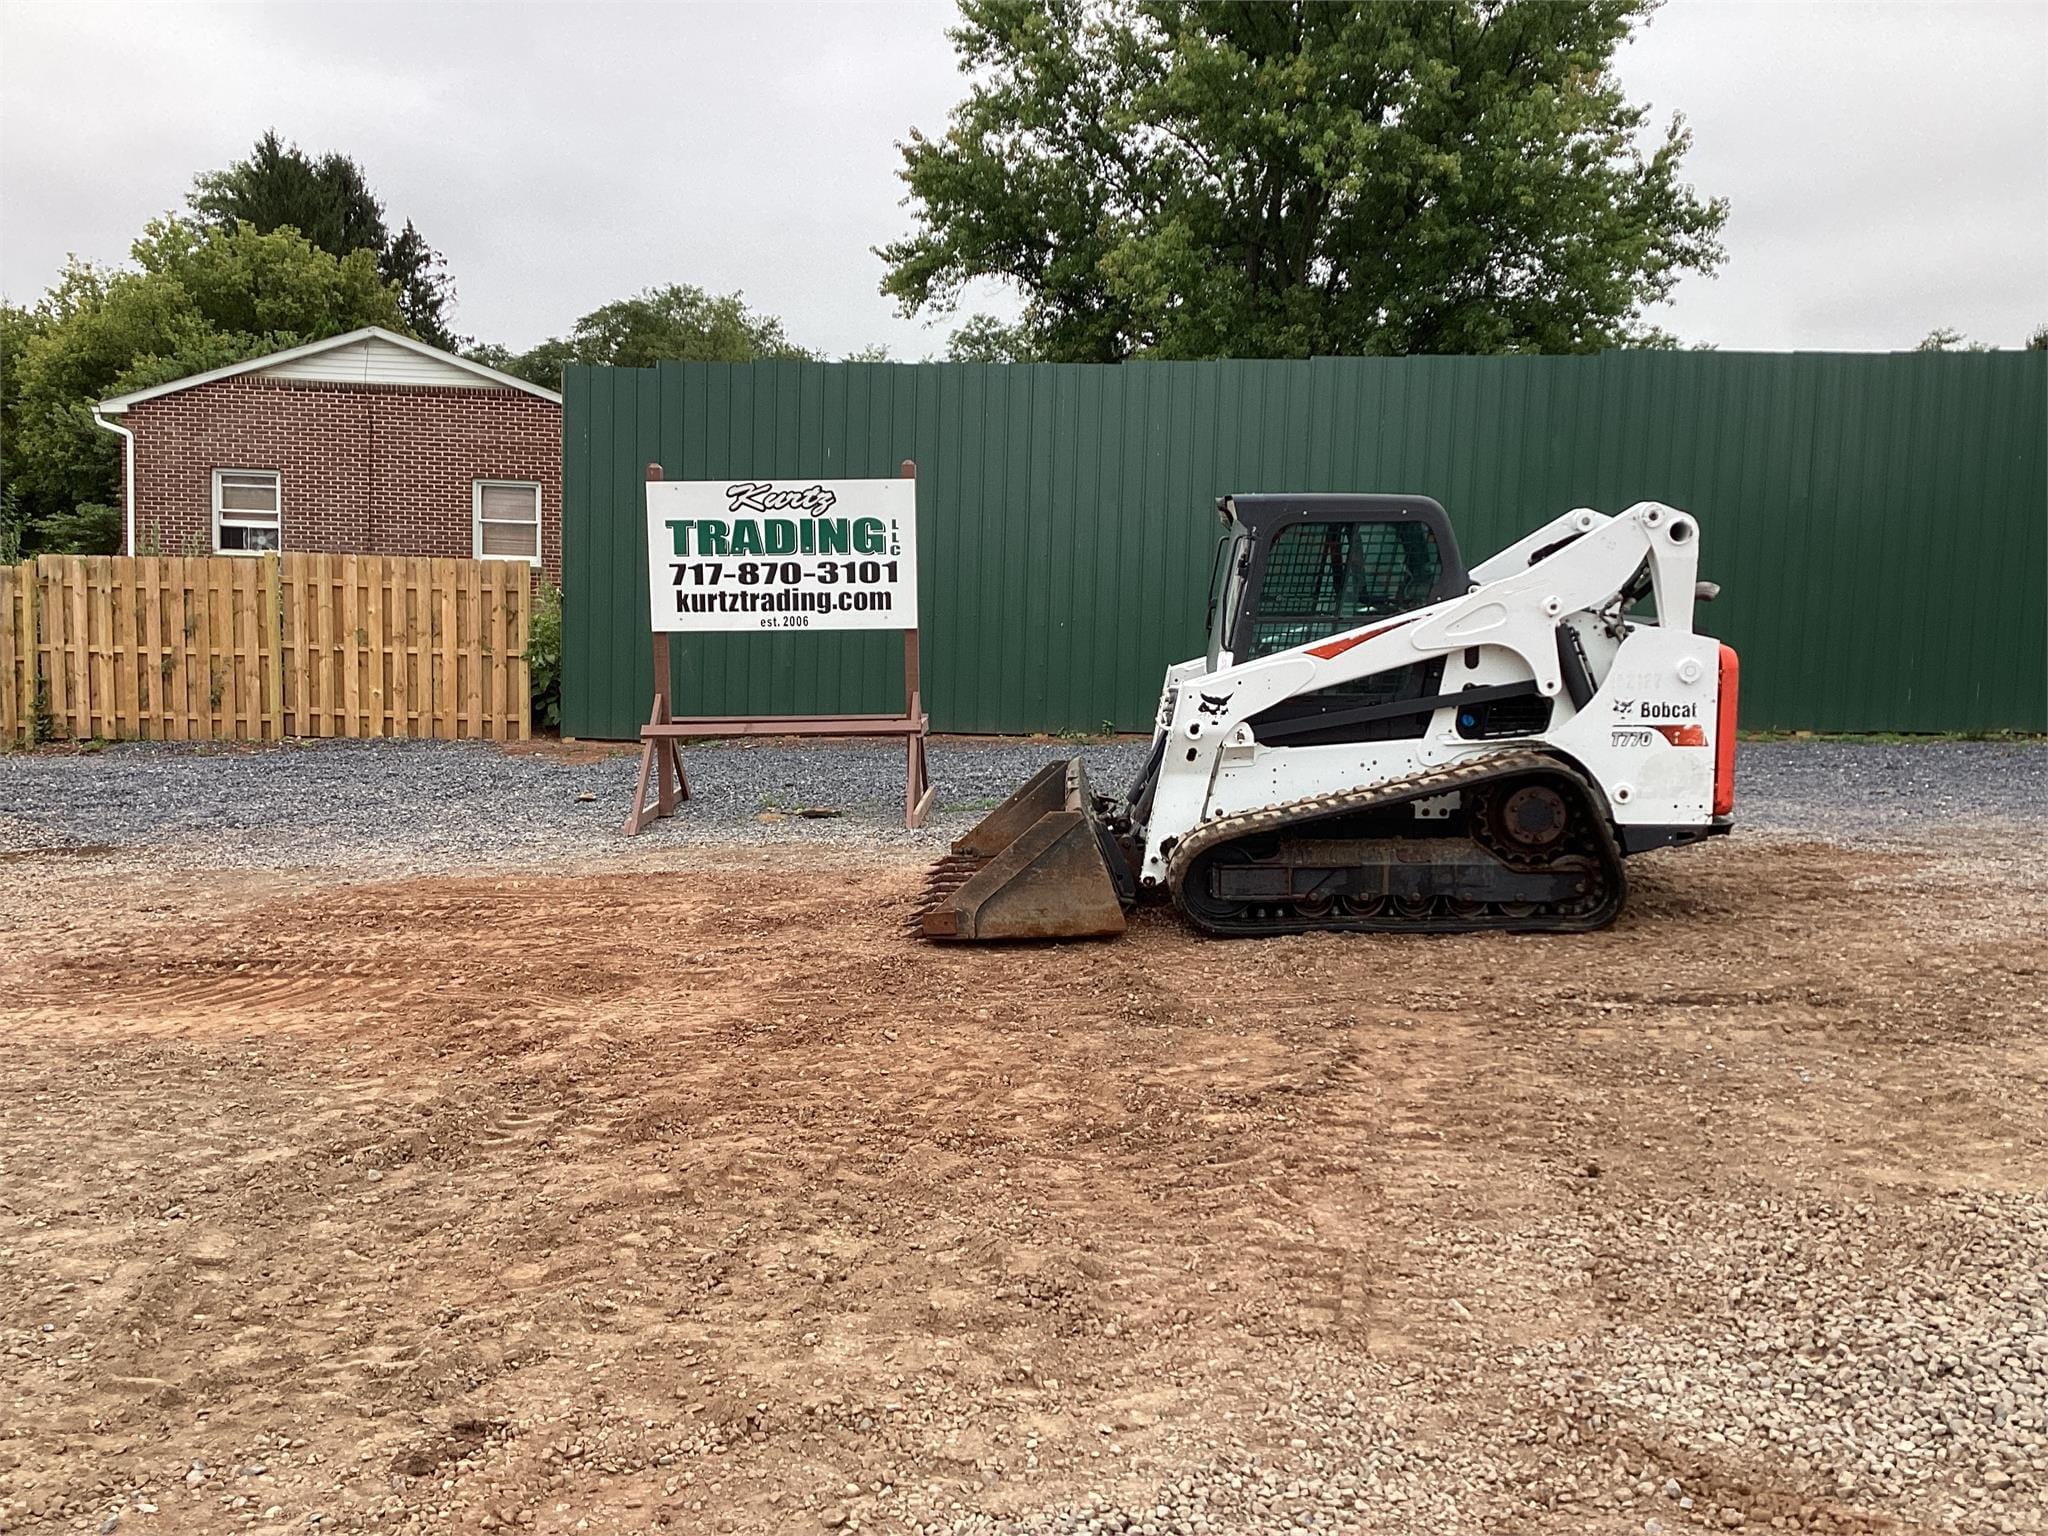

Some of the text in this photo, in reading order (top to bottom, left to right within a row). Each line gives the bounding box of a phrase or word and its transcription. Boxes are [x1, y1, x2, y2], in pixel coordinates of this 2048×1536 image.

[726, 483, 837, 517] Kurtz
[665, 517, 887, 557] TRADING
[890, 519, 901, 556] LLC
[668, 560, 898, 586] 717-870-3101
[675, 588, 892, 614] kurtztrading.com
[760, 616, 809, 628] est. 2006
[1640, 701, 1697, 718] Bobcat
[1611, 731, 1653, 747] T770
